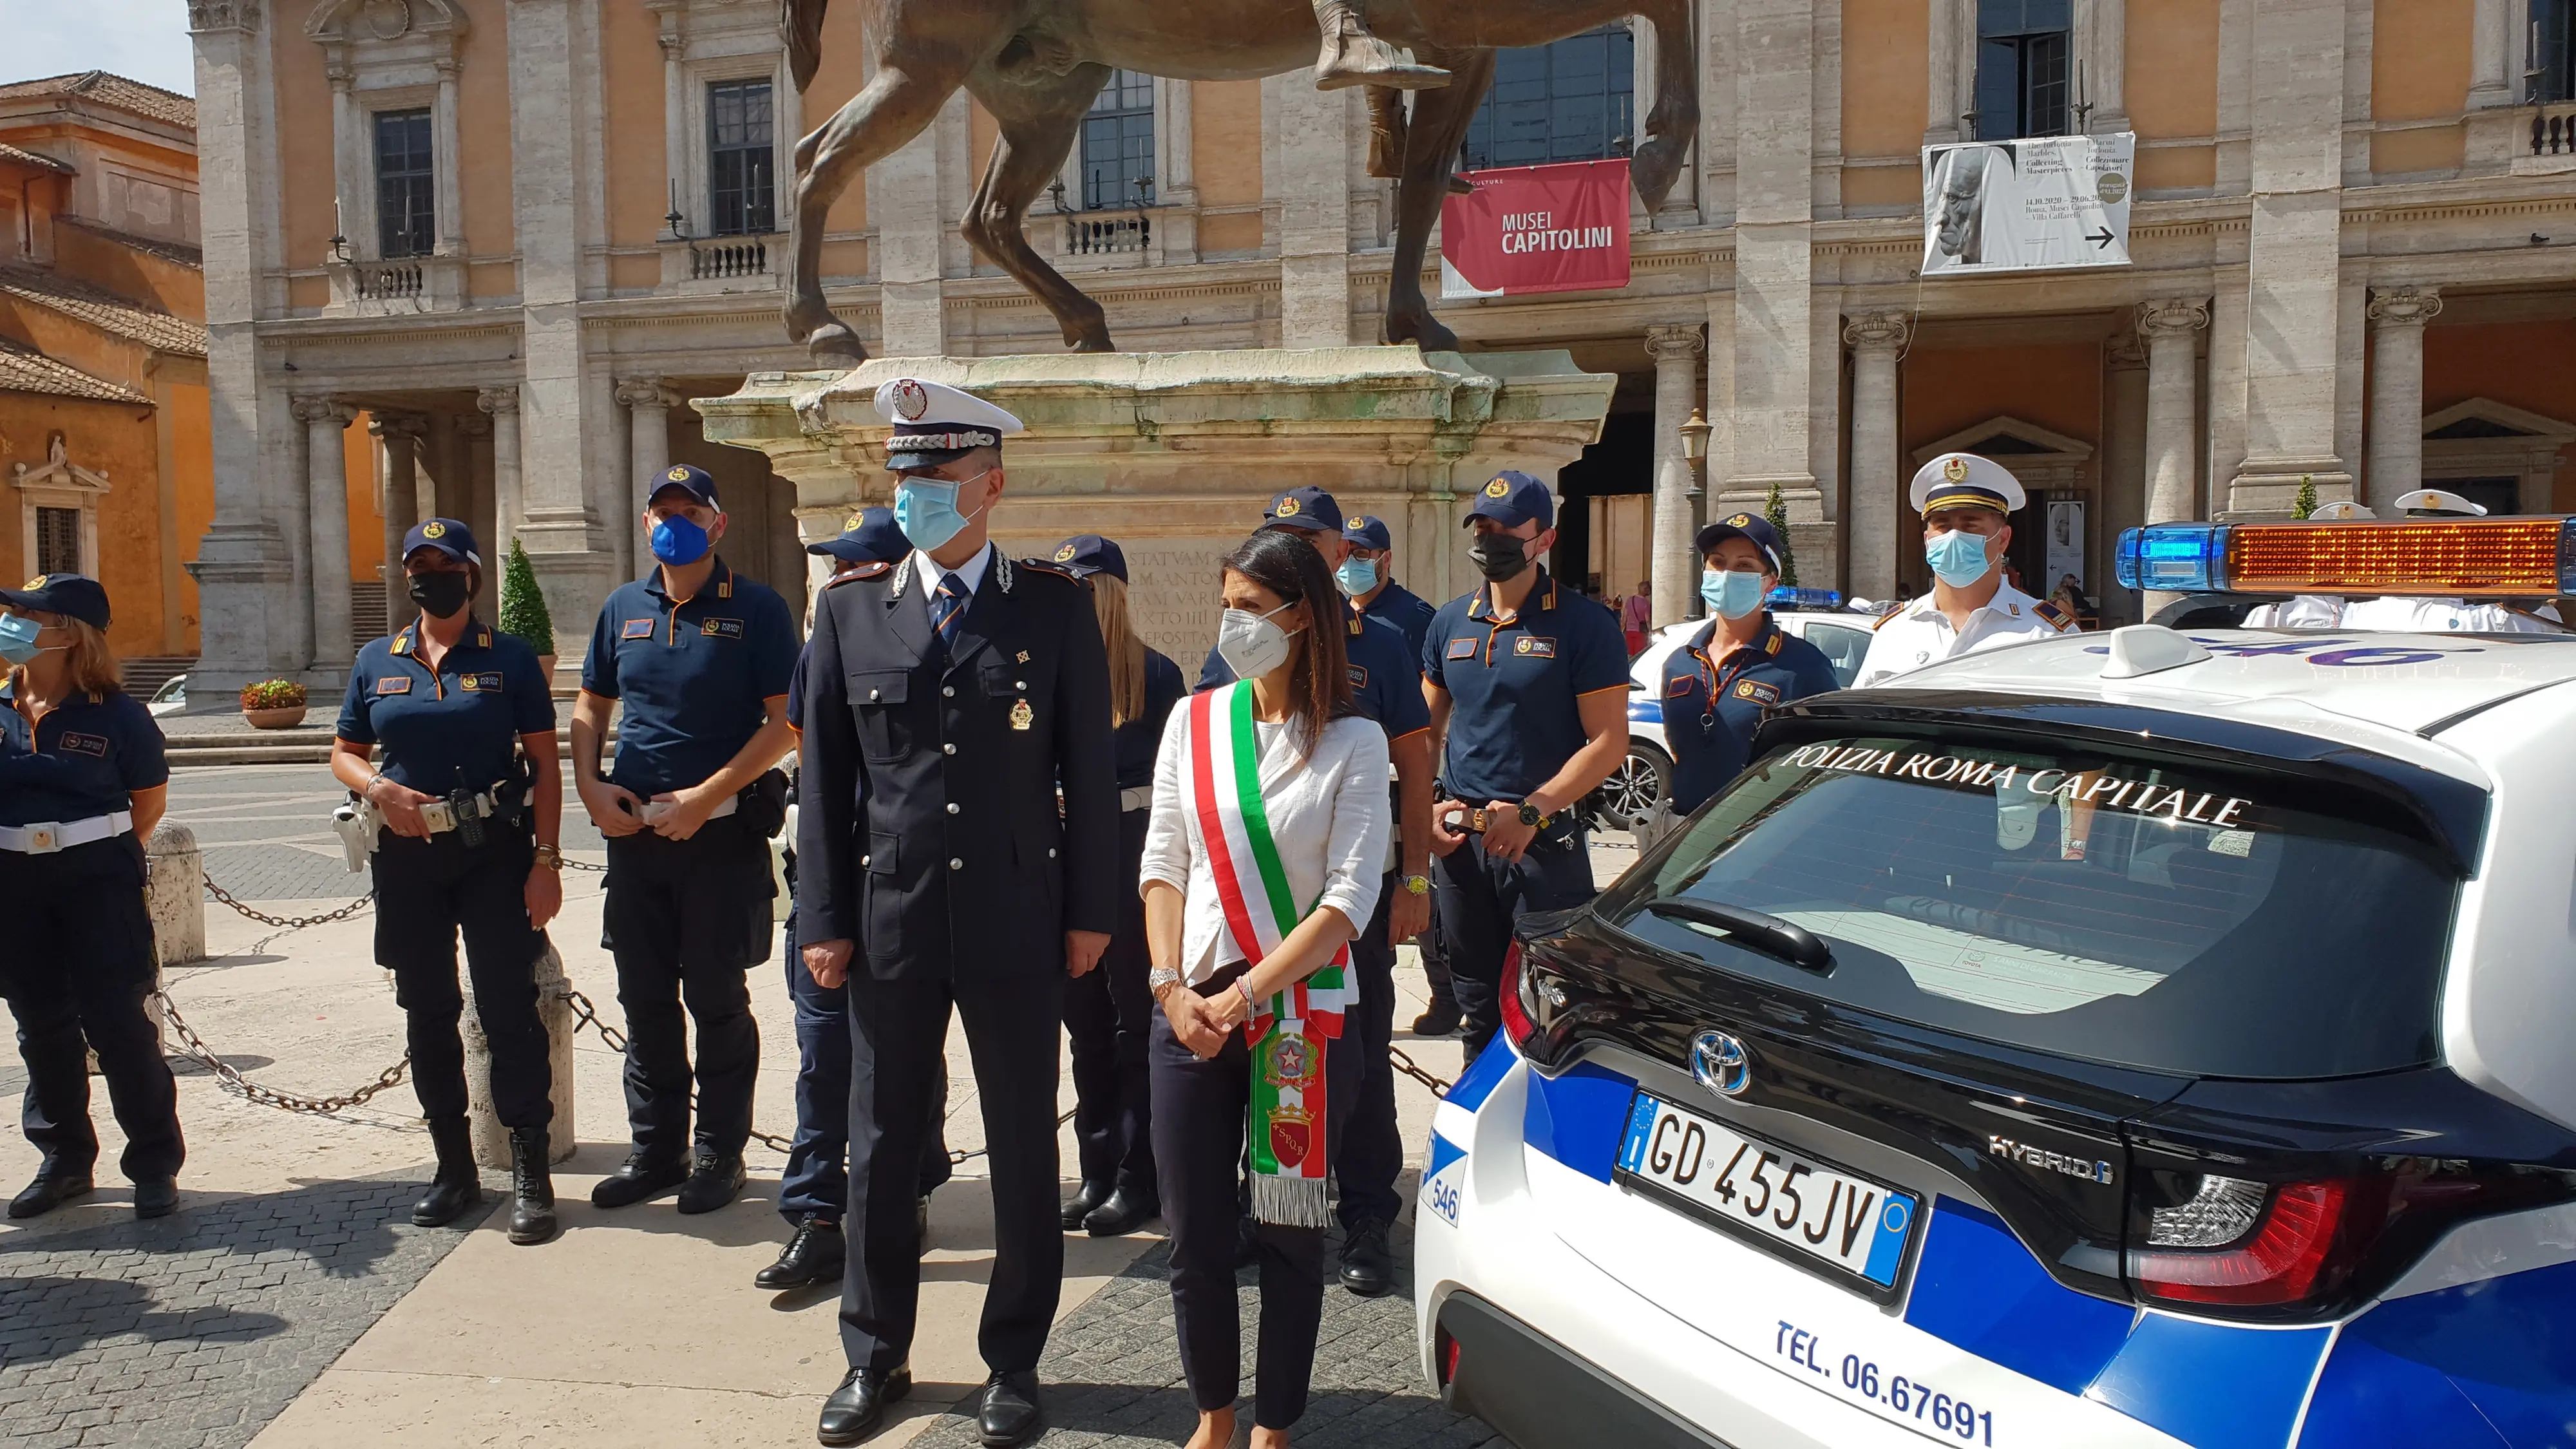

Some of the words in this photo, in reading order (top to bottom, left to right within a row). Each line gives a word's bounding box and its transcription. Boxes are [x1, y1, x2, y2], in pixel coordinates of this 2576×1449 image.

[2026, 158, 2063, 167] Collecting
[2026, 166, 2073, 175] Masterpieces
[2025, 196, 2062, 206] 14.10.2020
[1502, 211, 1551, 232] MUSEI
[2049, 211, 2081, 220] Caffarelli
[1502, 226, 1612, 254] CAPITOLINI
[1779, 745, 1897, 775] POLIZIA
[1895, 752, 2017, 790] ROMA
[2027, 768, 2253, 828] CAPITALE
[1962, 960, 1982, 969] TOYOTA
[1278, 1127, 1305, 1157] SPQR
[1988, 1135, 2093, 1179] HYBRID
[1432, 1177, 1458, 1220] 546
[1649, 1112, 1707, 1186] GD
[1713, 1142, 1875, 1258] 455JV
[1776, 1320, 1831, 1378] TEL.
[1842, 1354, 1993, 1448] 06.67691
